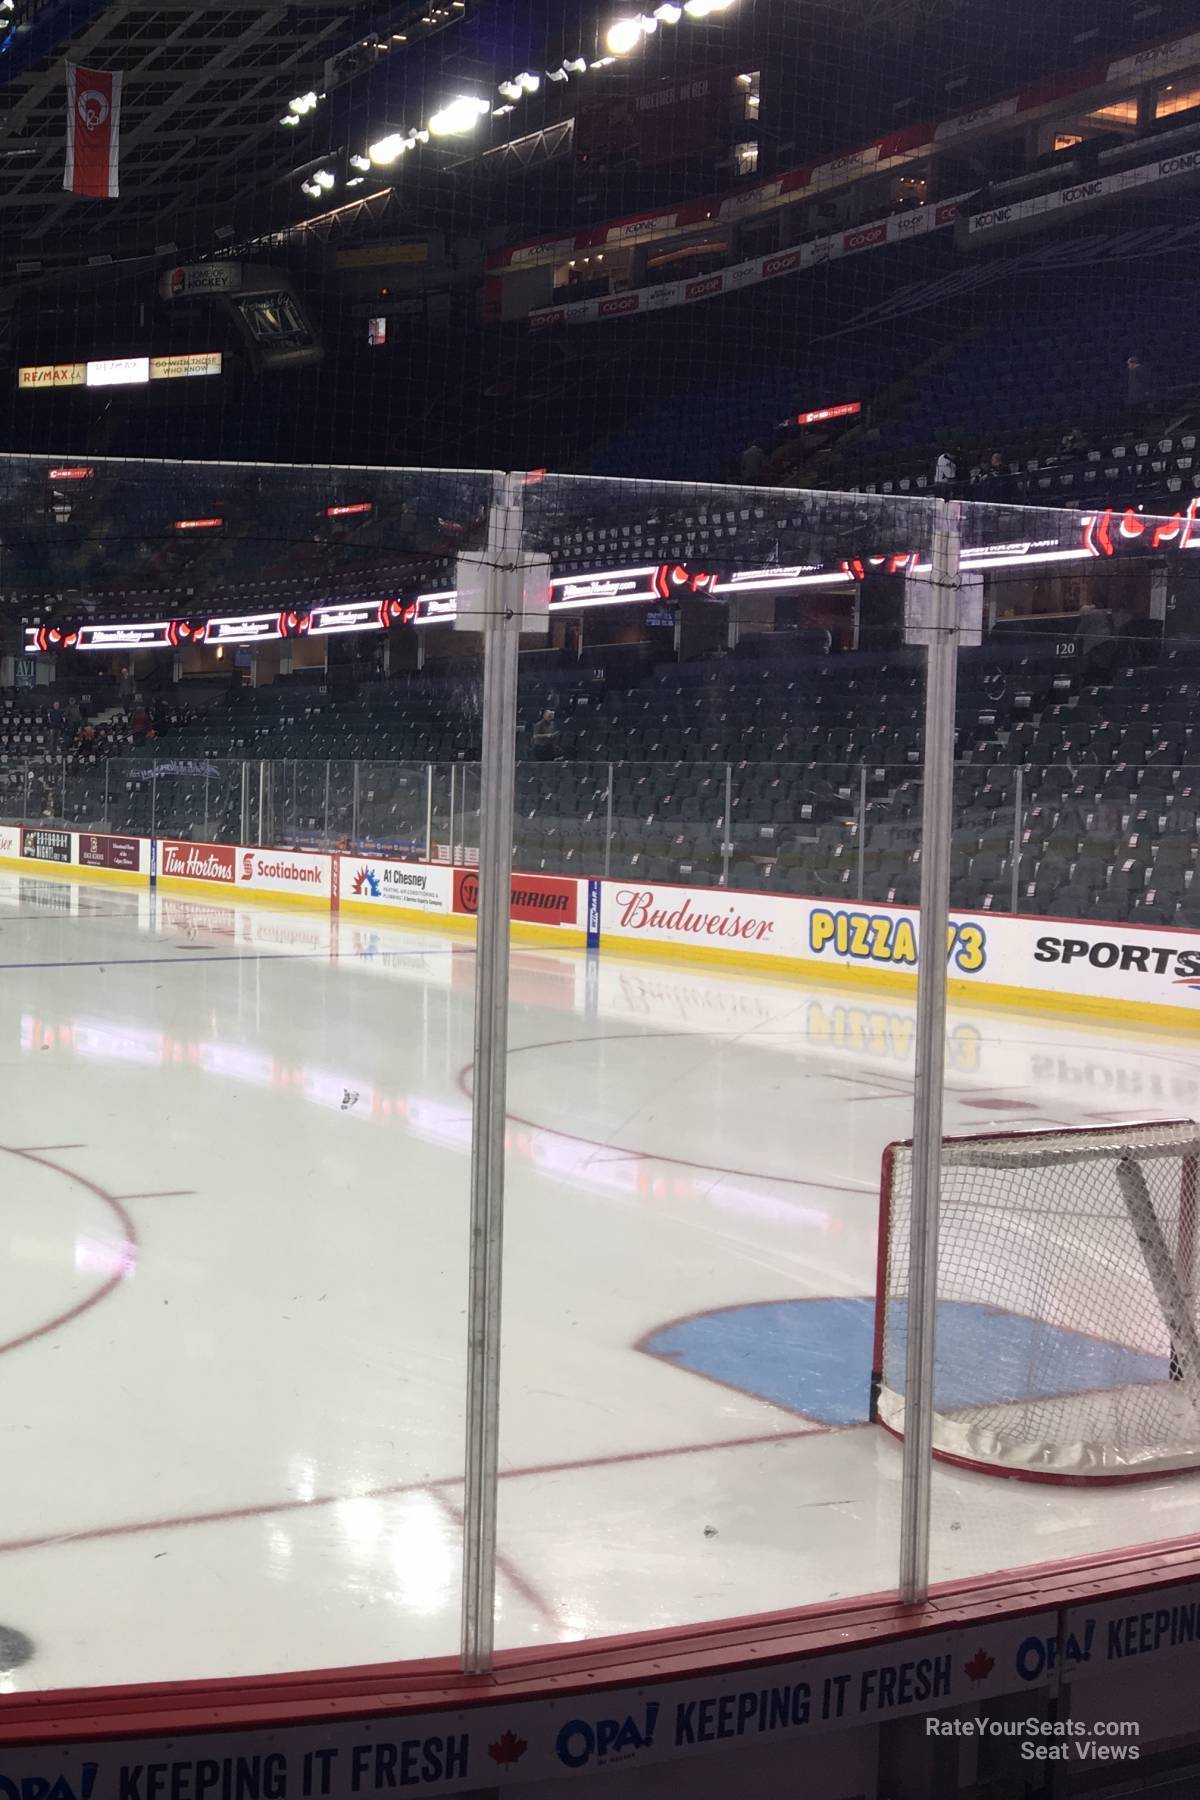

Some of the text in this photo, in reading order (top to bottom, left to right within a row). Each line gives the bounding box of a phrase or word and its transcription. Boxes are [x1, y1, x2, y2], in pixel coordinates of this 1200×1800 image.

[1062, 181, 1103, 204] ICONIC
[974, 207, 1012, 229] ICONIC
[188, 277, 228, 289] HOCKEY
[184, 365, 208, 373] KNOW
[1055, 642, 1075, 656] 120
[164, 846, 233, 881] Tim Hortons
[257, 860, 322, 884] Scotiabank
[383, 869, 427, 890] A1 Chesney
[615, 890, 774, 940] Budweiser
[809, 907, 917, 966] PIZZA
[1107, 1602, 1200, 1660] KEEPIN
[556, 1653, 953, 1768] OPA! KEEPING IT FRESH
[119, 1753, 289, 1800] KEEPING
[302, 1747, 340, 1797] IT
[351, 1733, 471, 1792] FRESH
